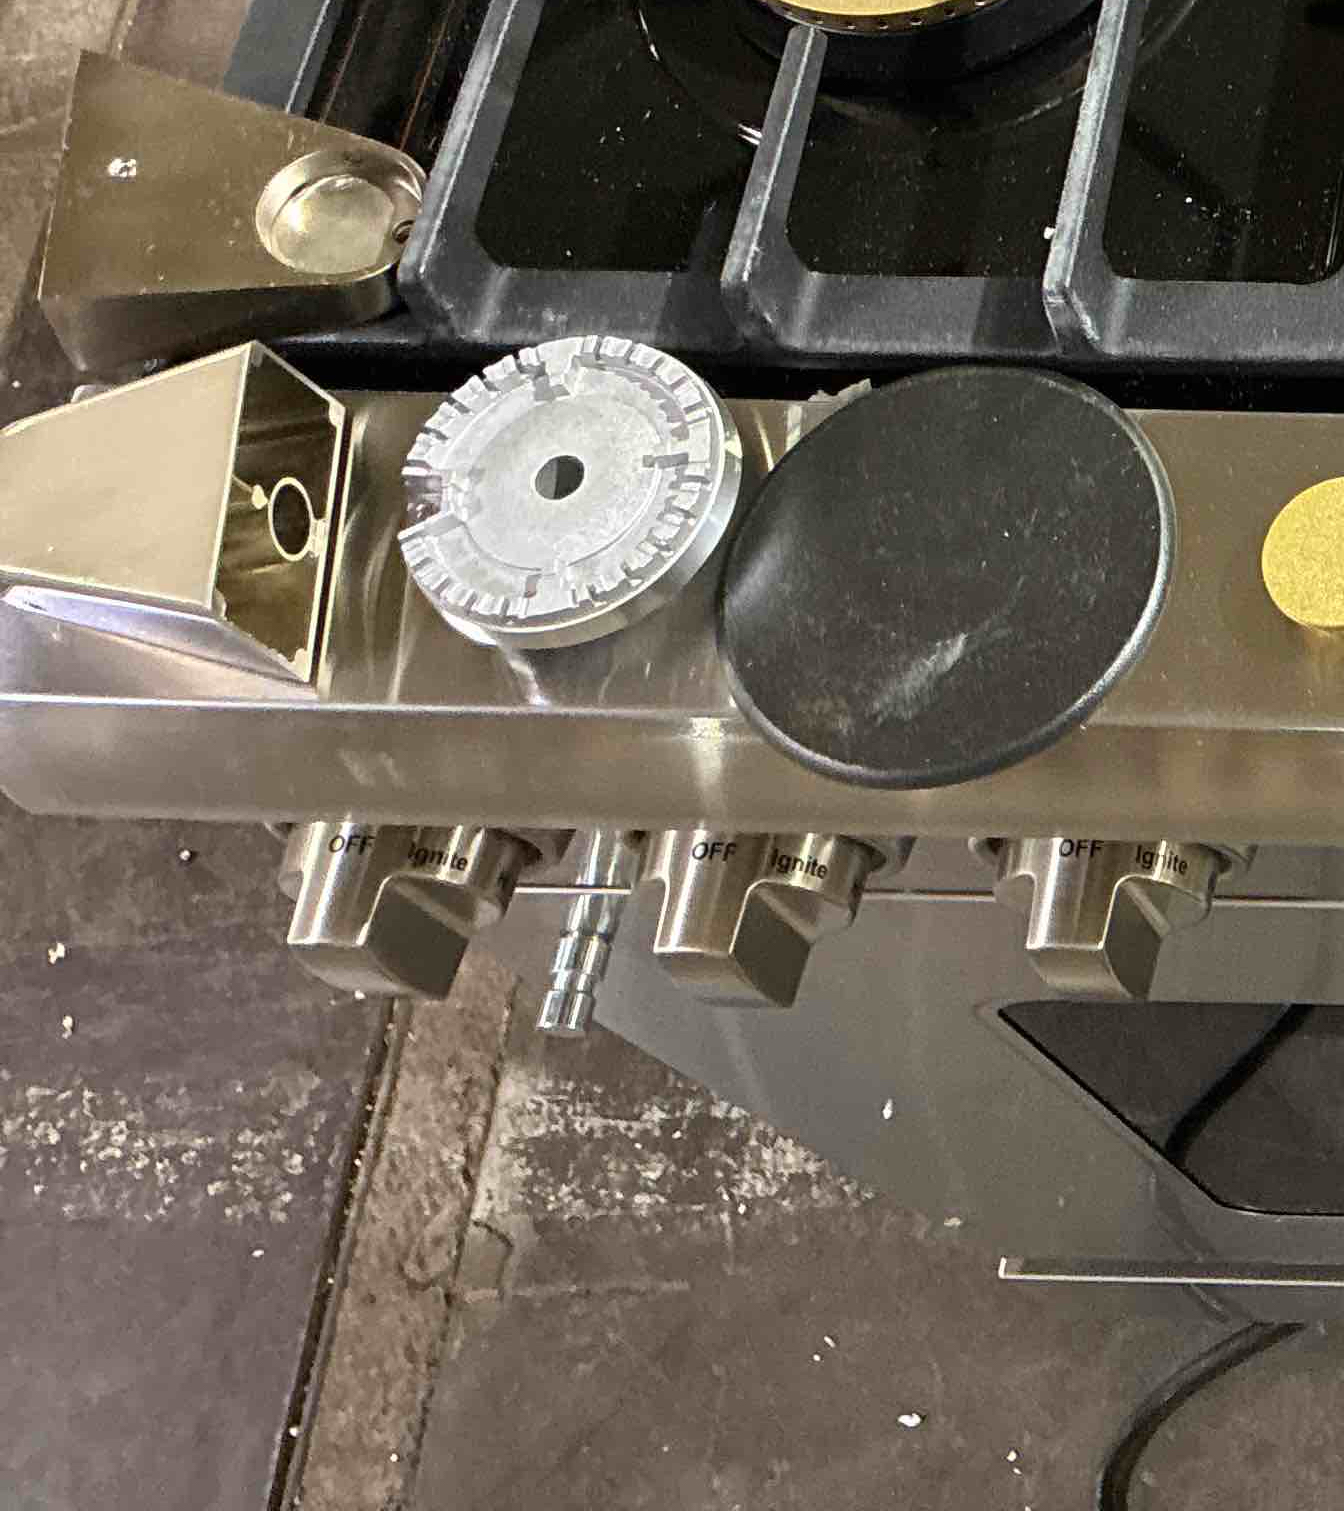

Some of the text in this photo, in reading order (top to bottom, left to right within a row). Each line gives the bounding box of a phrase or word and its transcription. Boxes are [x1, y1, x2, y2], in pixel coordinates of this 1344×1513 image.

[328, 834, 469, 872] OFF Ignite
[691, 841, 829, 879] OFF Ignite
[1058, 838, 1189, 875] OFF Ignite
